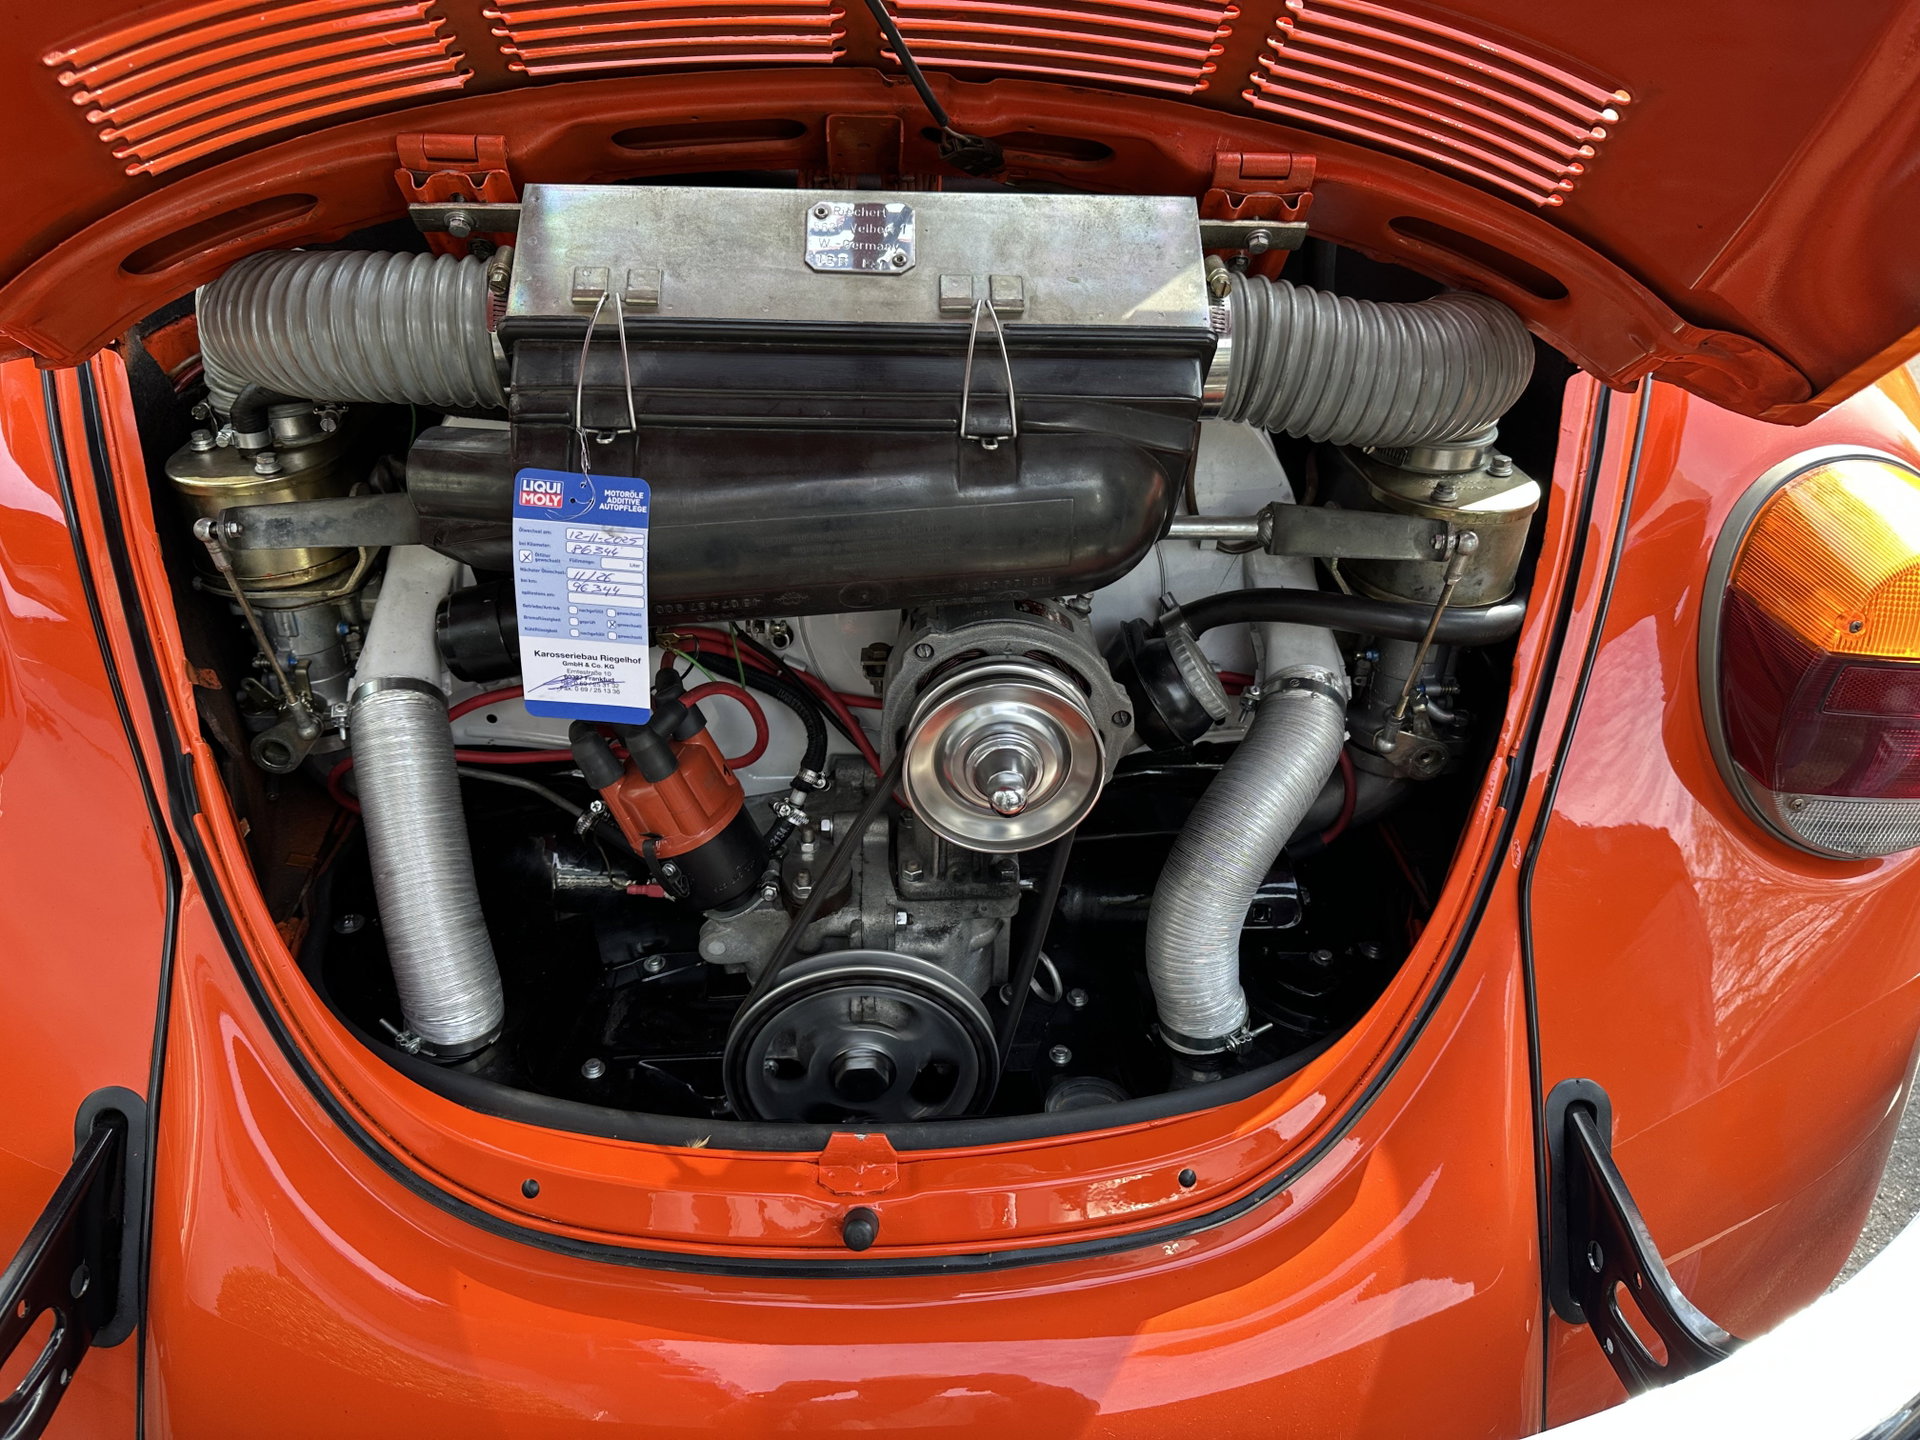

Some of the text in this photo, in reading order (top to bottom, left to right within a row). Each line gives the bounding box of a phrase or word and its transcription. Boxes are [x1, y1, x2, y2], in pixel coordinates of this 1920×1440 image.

[522, 479, 561, 494] LIQUI
[521, 492, 561, 507] MOLY
[604, 489, 644, 499] MOTORÖLE
[606, 497, 641, 506] ADDITIVE
[599, 503, 647, 513] AUTOPFLEGE
[534, 650, 642, 665] Karosseriebau Riegelhof
